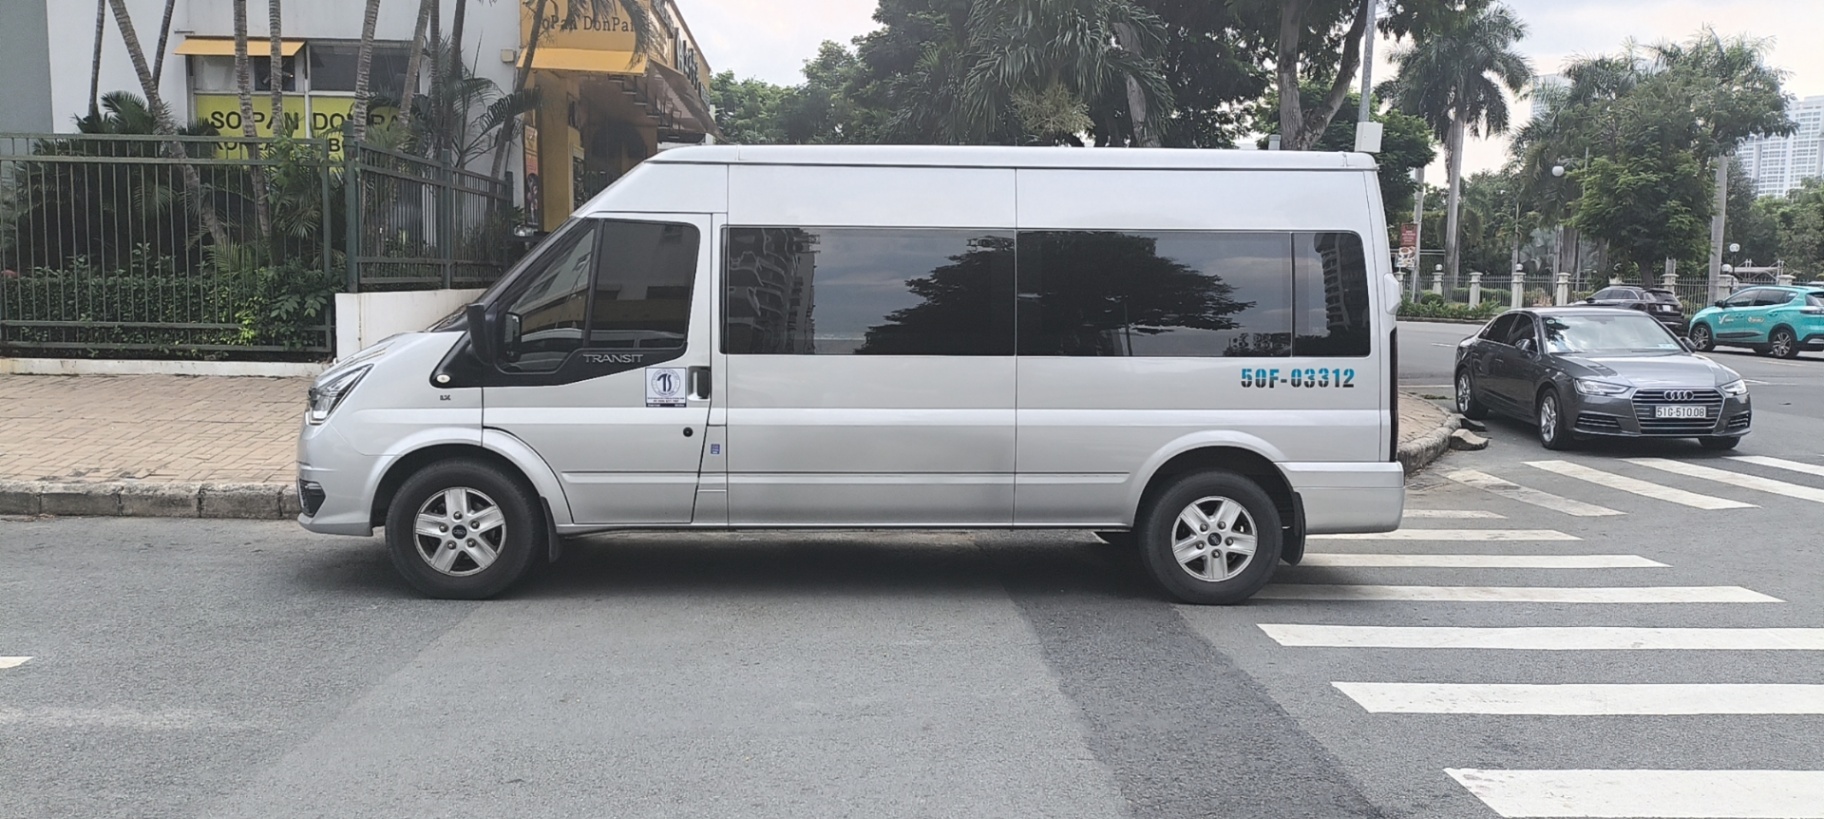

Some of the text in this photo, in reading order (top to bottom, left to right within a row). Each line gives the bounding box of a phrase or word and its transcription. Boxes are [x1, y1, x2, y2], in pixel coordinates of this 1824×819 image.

[211, 111, 242, 129] SO
[583, 354, 643, 363] TRANSIT
[1241, 368, 1355, 388] 50F-03312
